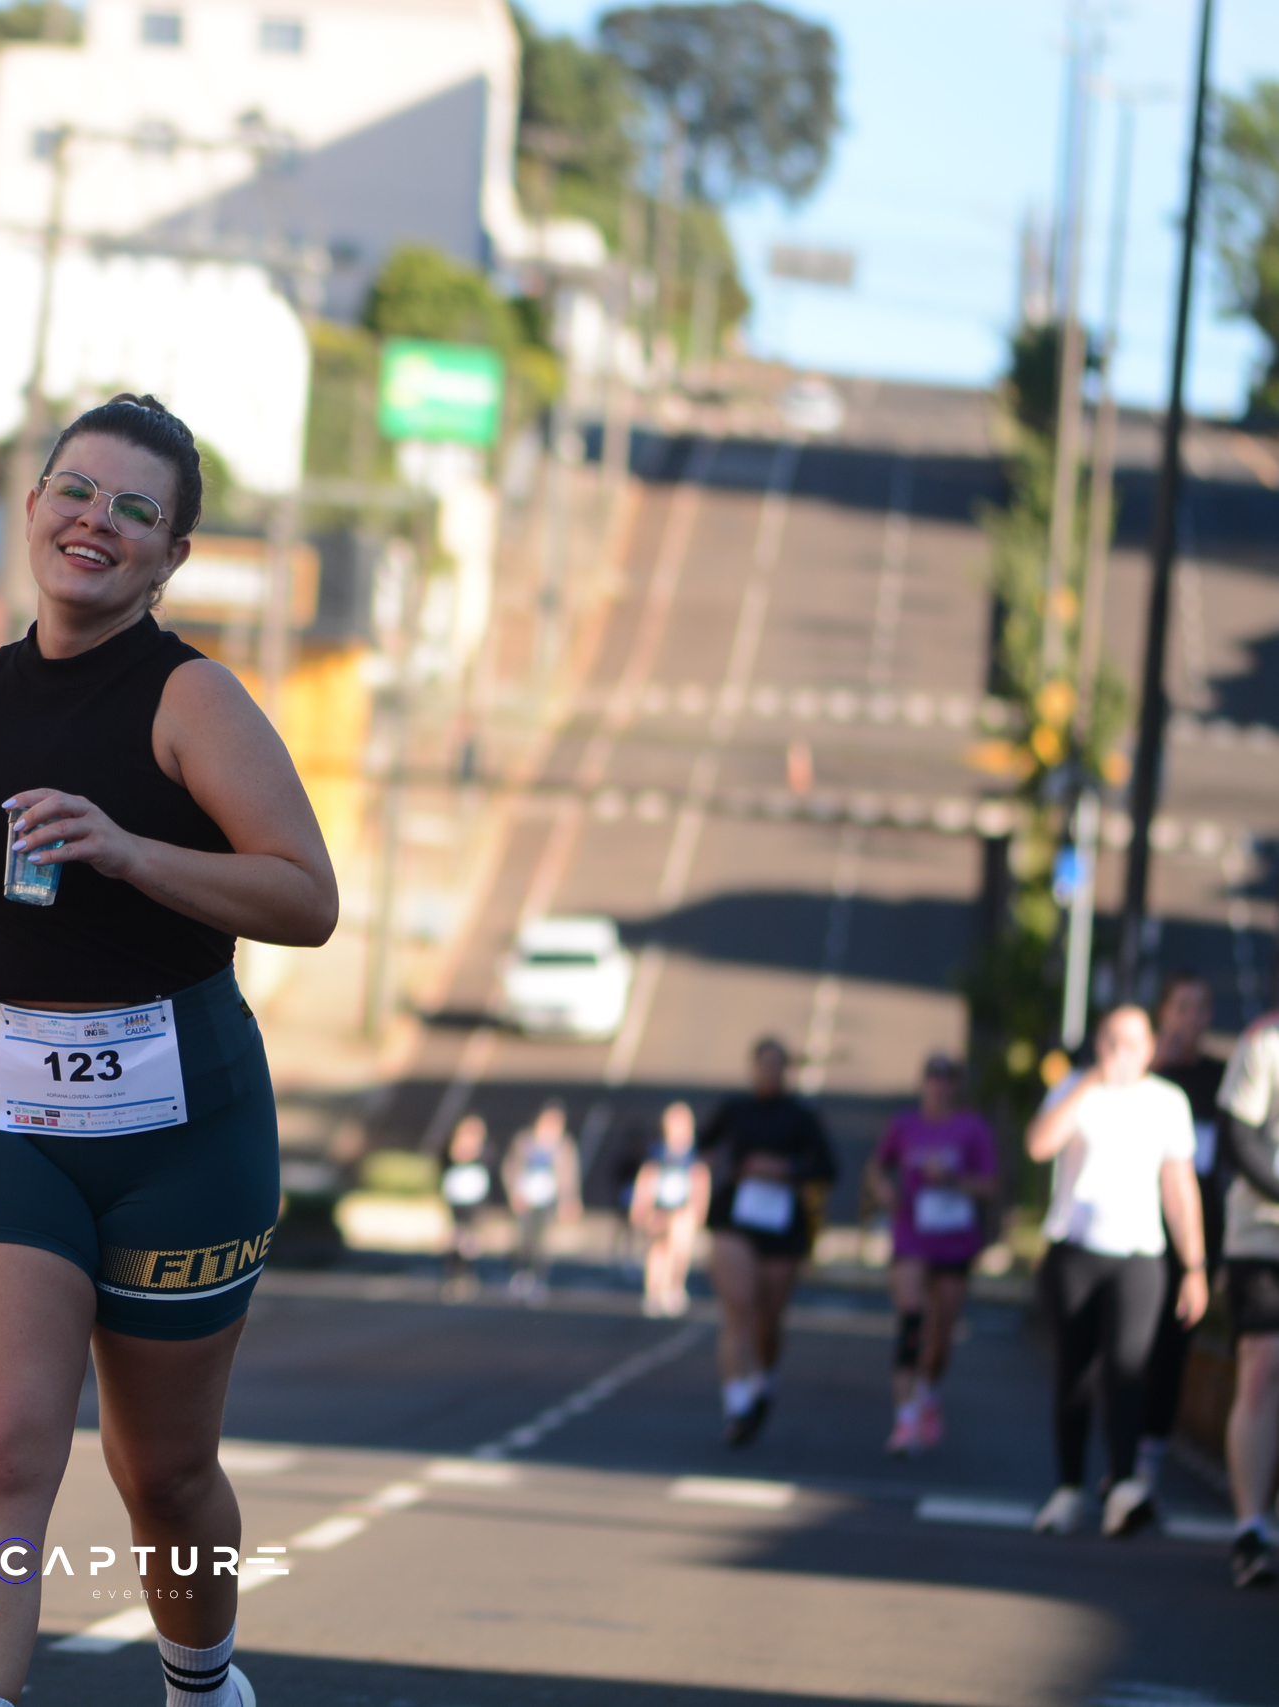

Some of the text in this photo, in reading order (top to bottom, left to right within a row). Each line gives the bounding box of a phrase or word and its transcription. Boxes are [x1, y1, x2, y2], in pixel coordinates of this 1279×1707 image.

[125, 1026, 152, 1036] CAUSA
[44, 1050, 122, 1082] 123
[22, 1107, 41, 1115] Sicredi
